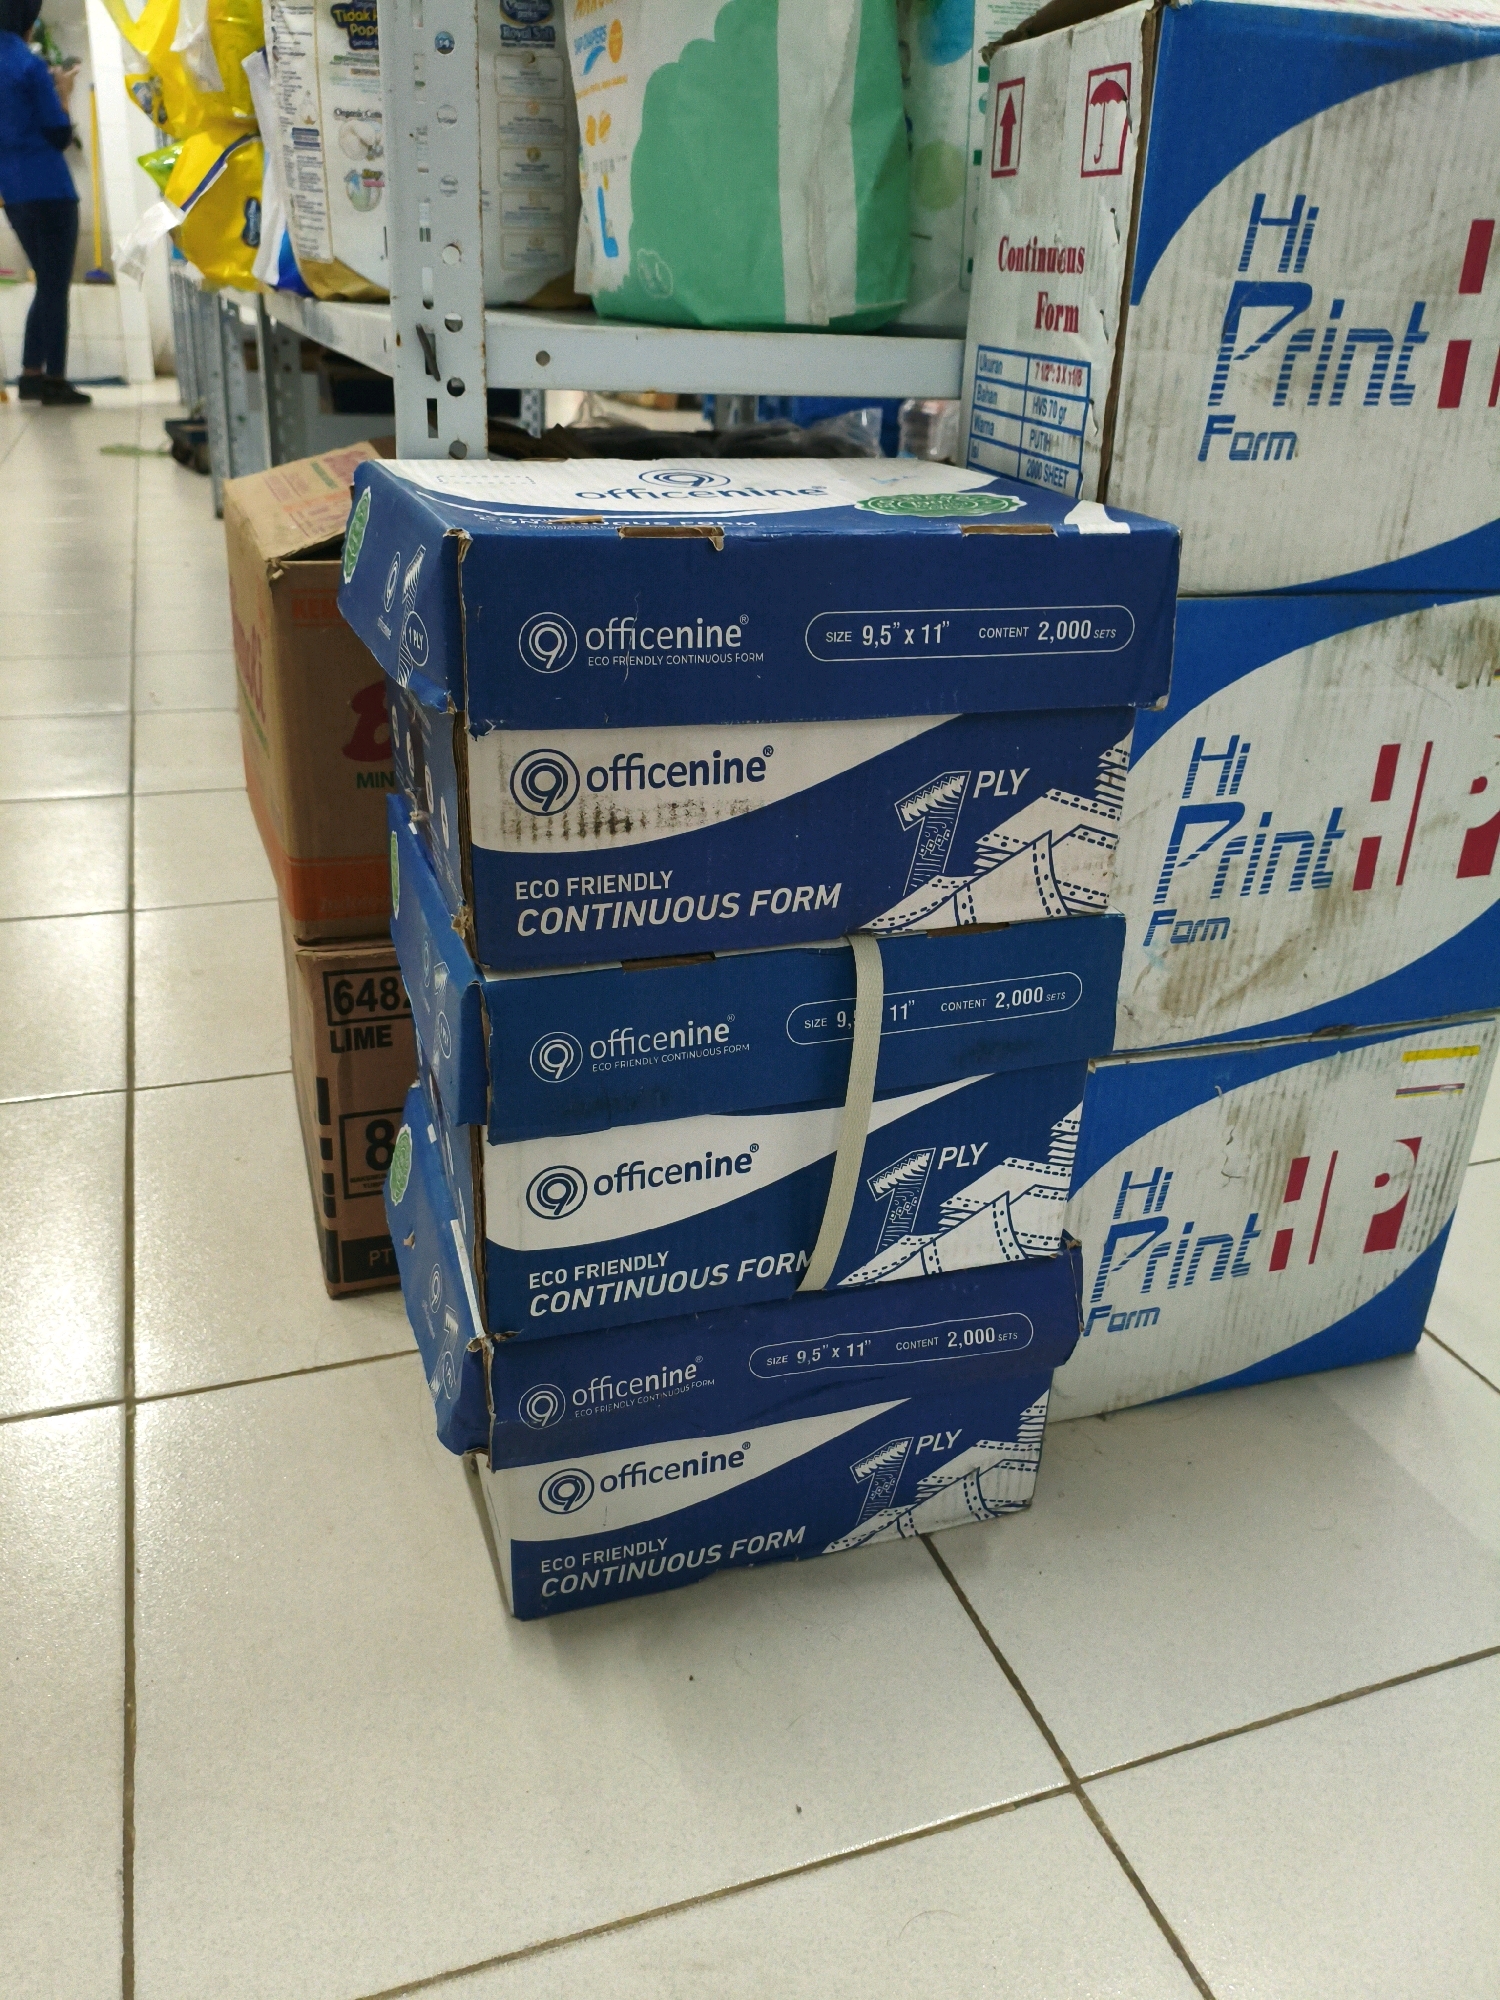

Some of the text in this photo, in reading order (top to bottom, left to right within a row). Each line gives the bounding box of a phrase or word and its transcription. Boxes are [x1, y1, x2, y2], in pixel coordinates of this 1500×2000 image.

[1237, 193, 1320, 273] Hi
[997, 235, 1086, 275] Continuous
[1034, 291, 1079, 333] Form
[1207, 280, 1430, 407] Print
[976, 383, 1067, 425] Bahan HVS 70 gr
[974, 415, 1051, 451] Warna PUTIH
[1197, 414, 1298, 462] Form
[1025, 458, 1043, 480] 2000
[1042, 463, 1069, 489] SHEET
[412, 631, 424, 651] PLY
[825, 631, 852, 643] SIZE
[904, 628, 915, 645] x
[978, 626, 1030, 639] CONTENT
[1037, 619, 1092, 644] 2,000
[1093, 628, 1117, 639] SETS
[588, 652, 764, 667] ECO FRIENDLY CONTINUOUS FORM
[972, 768, 1031, 799] PLY
[1181, 734, 1251, 799] Hi
[1152, 801, 1347, 904] Print
[515, 870, 673, 901] ECO FRIENDLY
[516, 882, 842, 937] CONTINUOUS FORM
[1142, 908, 1231, 947] Form
[333, 976, 411, 1016] 648
[804, 1017, 828, 1029] SIZE
[940, 998, 987, 1012] CONTENT
[994, 986, 1044, 1010] 2,000
[1045, 991, 1066, 1002] SETS
[329, 1024, 393, 1054] LIME
[592, 1043, 750, 1072] ECO FRIENDLY CONTINUOUS FORM
[365, 1118, 395, 1171] 8
[938, 1142, 989, 1170] PLY
[1112, 1166, 1174, 1219] Hi
[368, 1248, 392, 1267] PT
[529, 1250, 669, 1290] ECO FRIENDLY
[1089, 1212, 1262, 1303] Print
[529, 1263, 729, 1318] CONTINUOUS
[1082, 1304, 1161, 1337] Form
[765, 1354, 789, 1367] SIZE
[831, 1347, 840, 1359] x
[895, 1336, 940, 1351] CONTENT
[947, 1326, 996, 1349] 2,000
[997, 1331, 1018, 1342] SETS
[575, 1378, 715, 1418] ECO FRIENDLY CONTINUOUS FORM
[915, 1428, 963, 1456] PLY
[540, 1525, 807, 1598] CONTINUOUS FORM
[541, 1537, 668, 1574] ECO FRIENDLY
